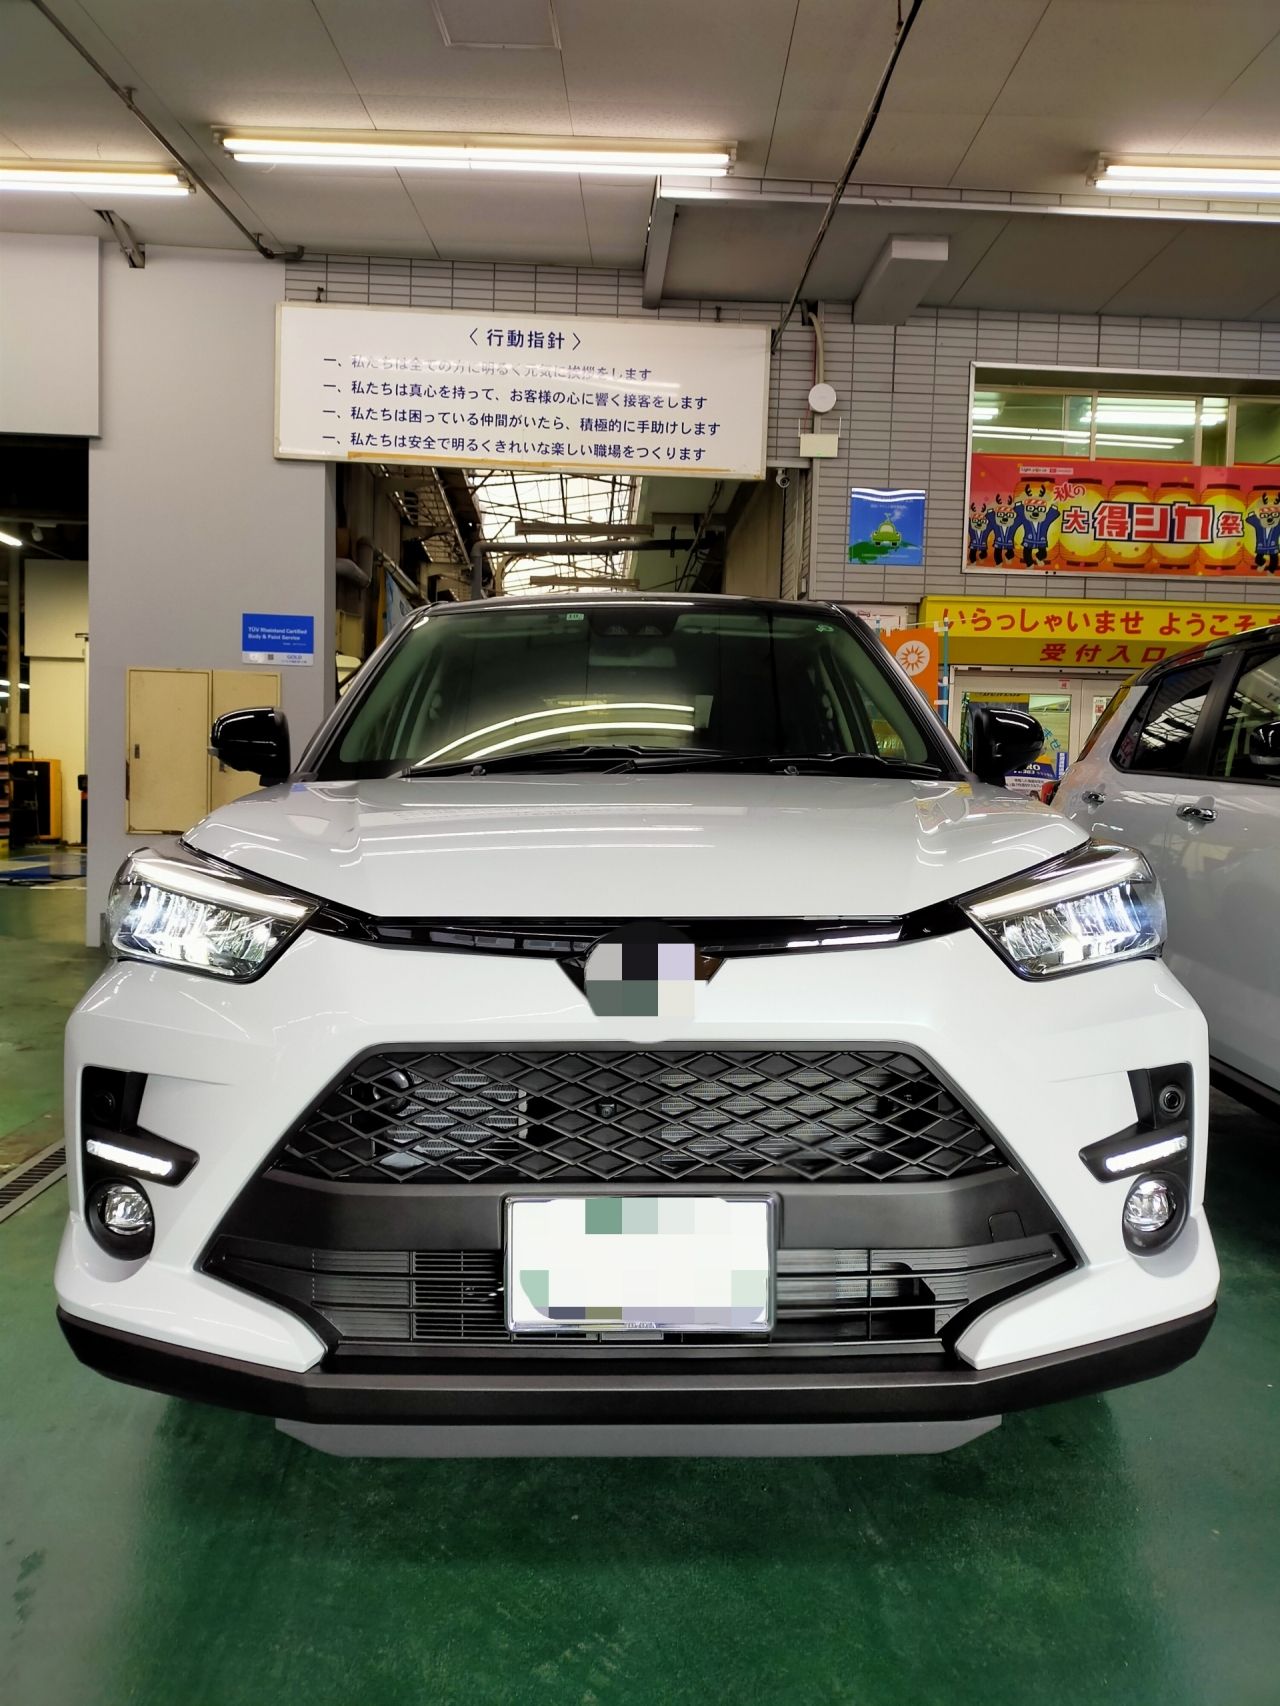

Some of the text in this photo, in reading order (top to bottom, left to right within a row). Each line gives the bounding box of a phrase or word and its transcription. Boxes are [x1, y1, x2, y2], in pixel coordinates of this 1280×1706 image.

[323, 380, 708, 410] 一、私たちは真心を持って、お客様の心に響く接客をします
[322, 406, 721, 436] 一、私たちは困っている仲間がいたら、積極的に手助けします
[322, 432, 707, 462] 一、私たちは安全で明るくきれいな楽しい職場をつくります
[1053, 482, 1085, 502] 秋の
[943, 607, 1256, 636] いらっしゃいませ ようこそ
[1040, 643, 1167, 664] 受付入口
